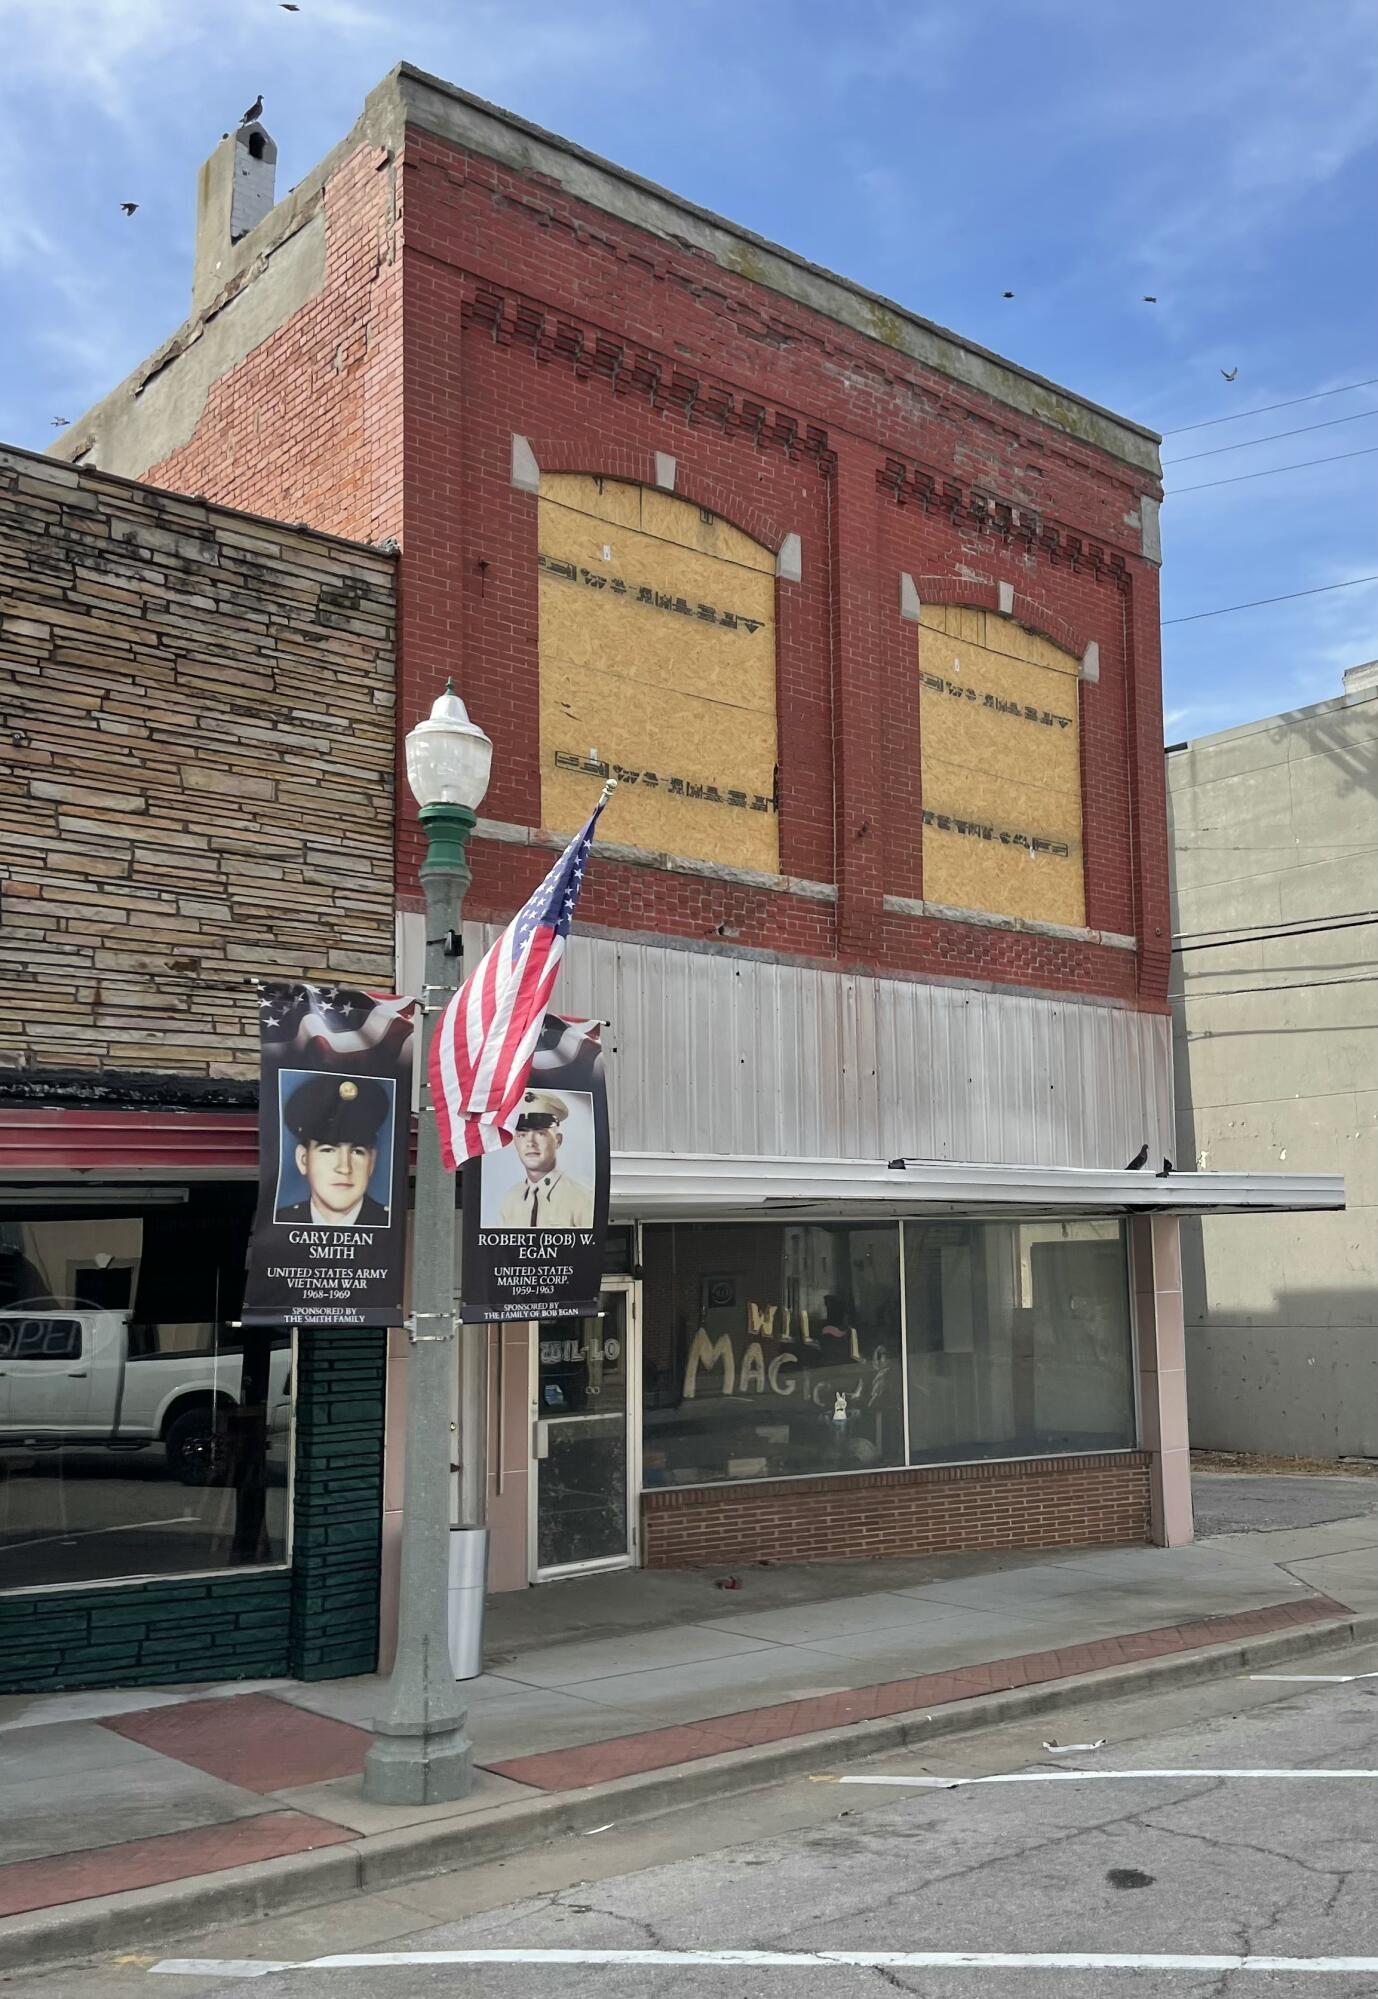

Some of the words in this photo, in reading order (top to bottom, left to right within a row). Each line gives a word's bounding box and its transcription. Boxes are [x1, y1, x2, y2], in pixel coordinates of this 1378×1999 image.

[289, 1231, 330, 1244] GARY
[333, 1232, 373, 1245] DEAN
[478, 1234, 536, 1246] ROBERT
[539, 1232, 576, 1248] (BOB)
[579, 1234, 596, 1246] W.
[309, 1246, 355, 1259] SMITH
[518, 1247, 558, 1259] EGAN
[267, 1267, 312, 1278] UNITED
[314, 1268, 354, 1278] STATES
[356, 1269, 388, 1279] ARMY
[494, 1266, 536, 1276] UNITED
[538, 1265, 574, 1275] STATES
[287, 1278, 339, 1288] VIETNAM
[341, 1279, 367, 1289] WAR
[497, 1276, 538, 1286] MARINE
[540, 1275, 569, 1285] CORP.
[303, 1290, 351, 1299] 1968-1969
[512, 1285, 554, 1296] 1959-1963
[292, 1307, 344, 1315] SPONSORED
[503, 1303, 548, 1311] SPONSORED
[549, 1302, 560, 1310] BY
[284, 1315, 303, 1323] THE
[304, 1315, 332, 1323] SMITH
[484, 1312, 500, 1320] THE
[501, 1310, 530, 1319] FAMILY
[530, 1309, 541, 1318] OF
[541, 1309, 558, 1317] BOB
[558, 1308, 579, 1316] EGAN
[683, 1327, 831, 1407] MAGIC
